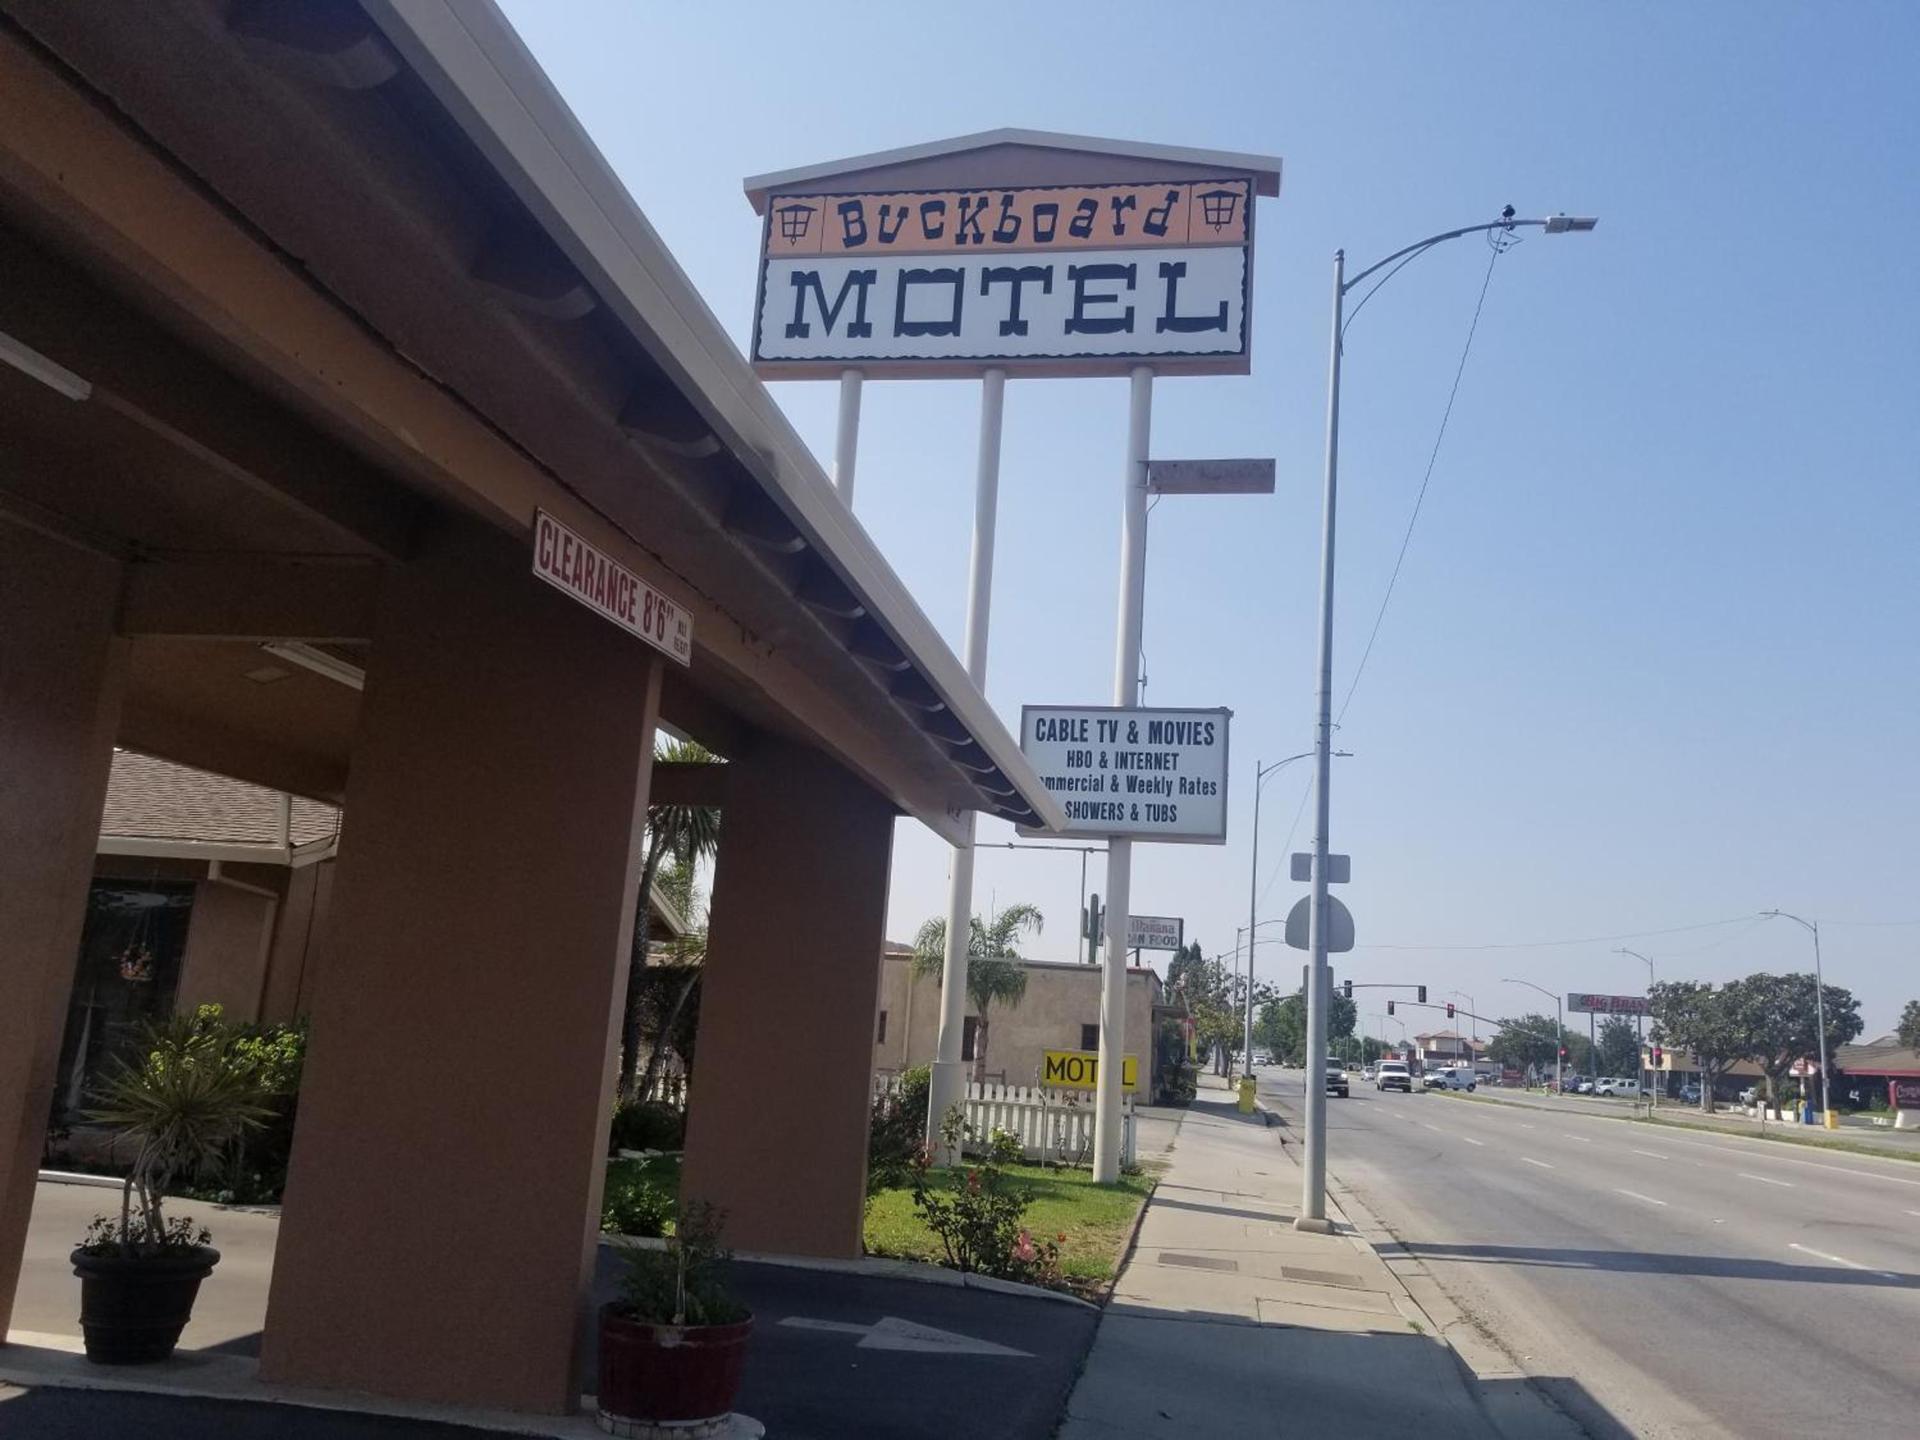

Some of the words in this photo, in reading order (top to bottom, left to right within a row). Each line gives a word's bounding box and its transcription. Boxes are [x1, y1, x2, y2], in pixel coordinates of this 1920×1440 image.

[784, 261, 1230, 339] MOTEL
[538, 518, 638, 625] CLEARANCE
[1035, 717, 1089, 743] CABLE
[1096, 719, 1120, 744] TV
[1126, 720, 1140, 744] &
[1148, 720, 1215, 746] MOVIES
[1066, 750, 1093, 769] HBO
[1098, 751, 1109, 769] &
[1114, 751, 1180, 771] INTERNET
[1039, 774, 1105, 793] mmercial
[1110, 775, 1120, 793] &
[1126, 775, 1173, 797] Weekly
[1178, 776, 1217, 796] Rates
[1064, 800, 1125, 822] SHOWERS
[1130, 803, 1140, 822] &
[1144, 803, 1177, 823] TUBS
[1046, 1055, 1135, 1086] MOTL
